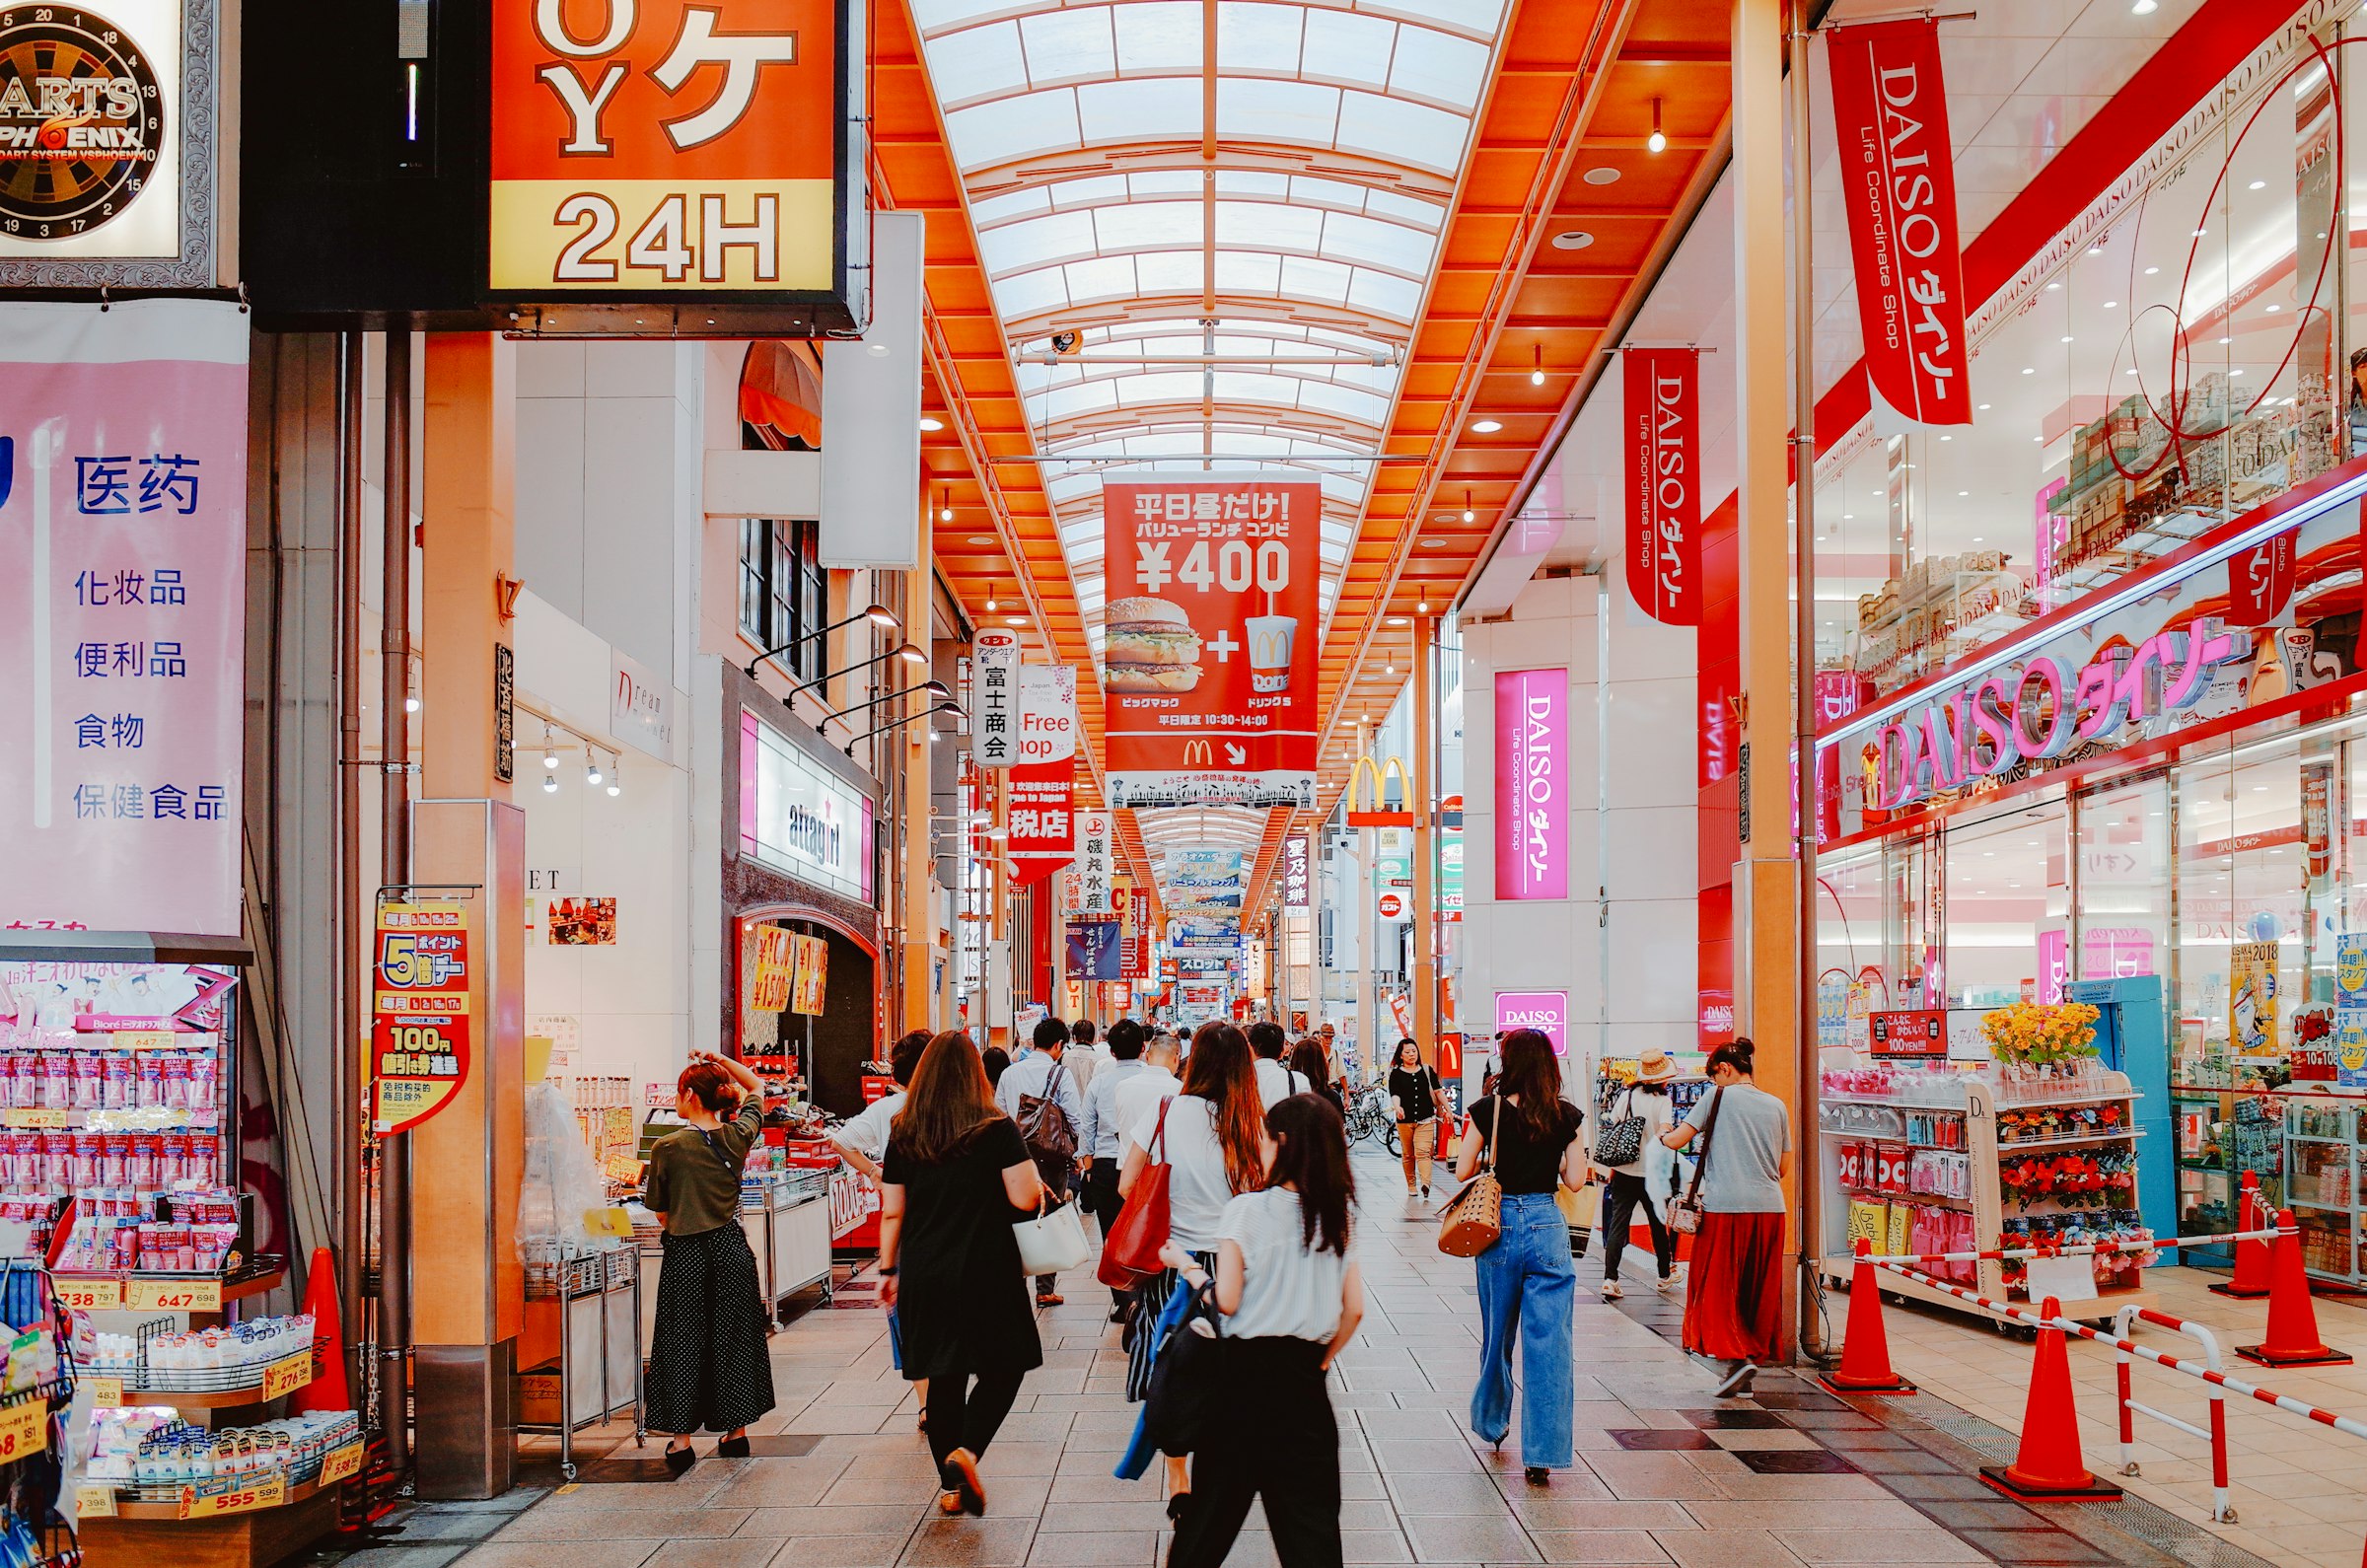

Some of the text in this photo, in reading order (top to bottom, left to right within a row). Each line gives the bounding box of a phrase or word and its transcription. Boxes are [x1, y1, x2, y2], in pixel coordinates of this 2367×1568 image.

[4, 15, 13, 26] 5
[36, 9, 52, 22] 20
[74, 15, 80, 27] 1
[102, 32, 117, 44] 18
[127, 55, 138, 67] 4
[645, 3, 799, 154] ケ
[141, 87, 157, 98] 13
[148, 118, 157, 129] 6
[31, 150, 78, 160] SYSTEM
[126, 179, 141, 190] 15
[104, 203, 112, 215] 2
[2086, 178, 2132, 234] DAISO
[5, 220, 20, 232] 19
[40, 225, 49, 236] 3
[71, 220, 86, 231] 17
[1879, 62, 1954, 400] DAISO ダイソー
[553, 191, 780, 283] 24H
[1860, 125, 1899, 349] Life Coordinate Shop
[74, 454, 199, 515] 医药
[1639, 414, 1651, 569] Life Coordinate Shop
[1657, 376, 1685, 608] DAISO ダイソー
[1134, 492, 1290, 521] 平日昼だけ!
[1136, 522, 1289, 537] バリューランチ コンビ
[1136, 539, 1290, 593] ¥400
[74, 569, 185, 606] 化妆品
[74, 641, 185, 677] 便利品
[984, 667, 1007, 759] 富士商会
[1159, 715, 1201, 725] 平日限定
[1878, 655, 2076, 811] DAISO
[2075, 617, 2249, 739] ダイソー
[74, 713, 145, 748] 食物
[1024, 713, 1070, 732] Free
[1512, 728, 1522, 851] Life Coordinate Shop
[1528, 694, 1552, 883] DAISO ダイソー
[73, 783, 229, 820] 保健食品
[789, 795, 840, 868] attagirl
[530, 870, 560, 890] ET
[1086, 839, 1104, 909] 磯丸水産
[1286, 838, 1307, 904] 星乃珈琲
[386, 913, 410, 926] 毎月
[418, 936, 463, 950] ポイント
[2253, 944, 2278, 962] 2018
[1182, 959, 1225, 970] スロット
[381, 996, 407, 1010] 毎月
[94, 1020, 120, 1029] Bioré
[1505, 1011, 1558, 1023] DAISO
[1887, 1015, 1911, 1026] こんなに
[390, 1027, 451, 1052] 100円
[1897, 1026, 1921, 1036] かわいい
[381, 1053, 460, 1075] 値引き券進呈
[384, 1083, 431, 1092] 免税购买的
[384, 1093, 422, 1102] 商品除外
[1972, 1164, 1981, 1224] Coordinate
[158, 1294, 194, 1307] 647
[281, 1372, 298, 1390] 276
[97, 1391, 117, 1400] 483
[216, 1488, 279, 1510] 555 599
